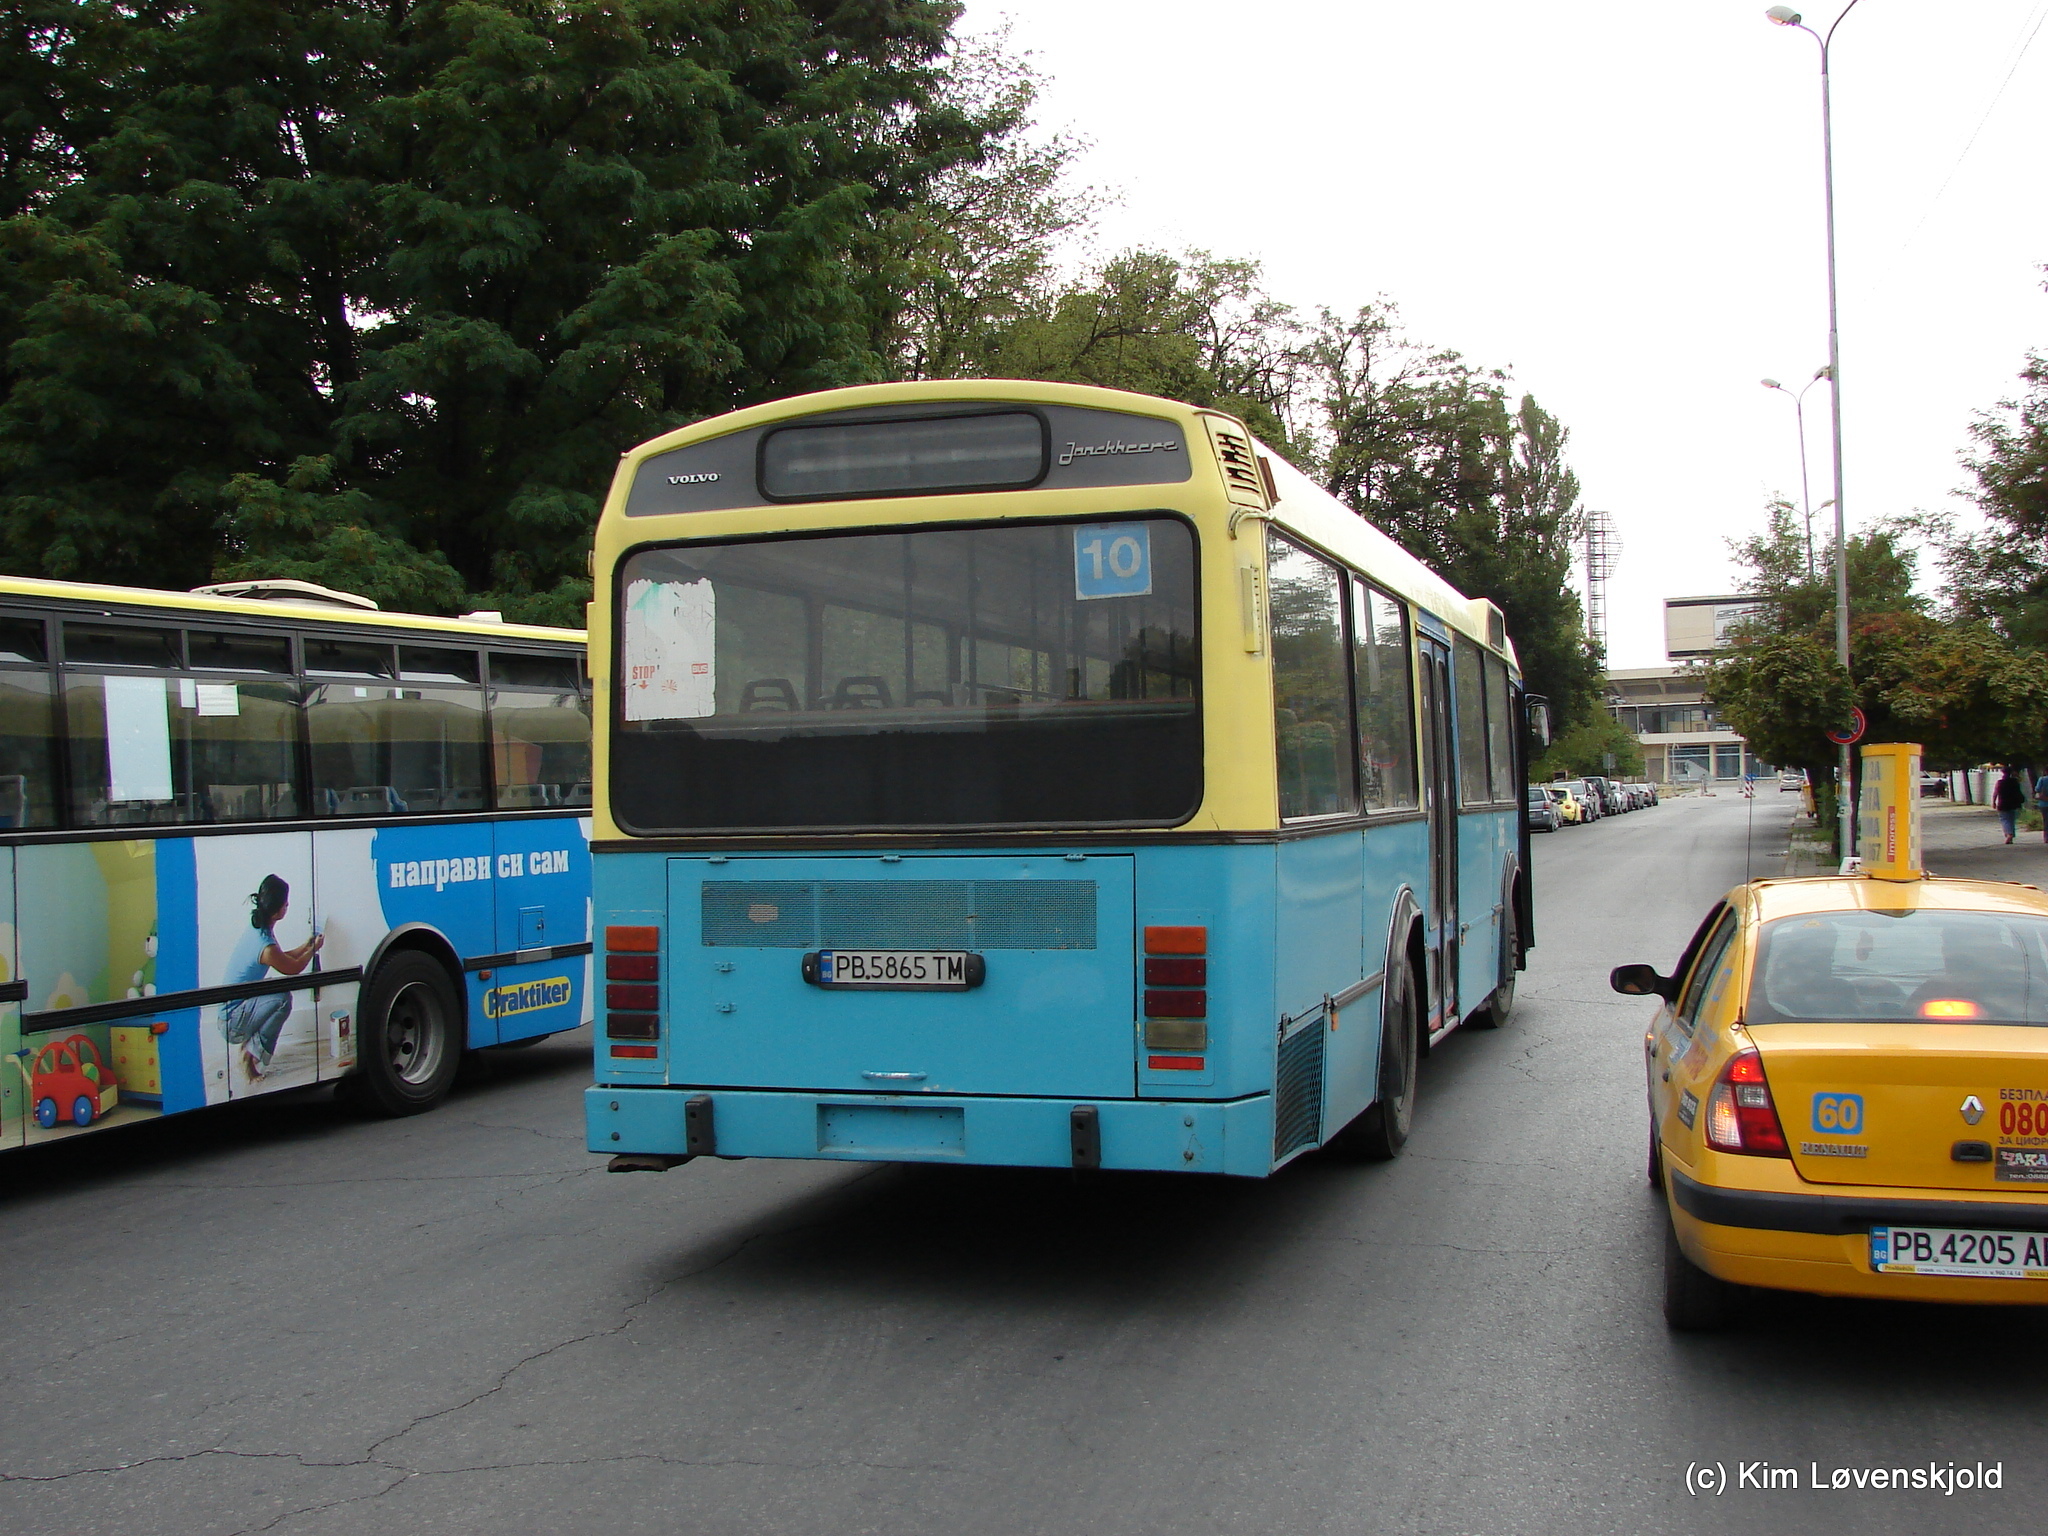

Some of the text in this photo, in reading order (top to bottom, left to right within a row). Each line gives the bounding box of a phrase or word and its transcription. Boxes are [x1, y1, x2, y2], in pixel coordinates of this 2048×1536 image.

[667, 472, 720, 485] VOLVO
[1082, 536, 1141, 579] 10
[632, 666, 655, 679] STOP
[390, 850, 569, 892] направи си сам
[933, 956, 963, 980] TM
[488, 981, 569, 1018] Praktiker
[1819, 1098, 1858, 1130] 60
[2000, 1102, 2048, 1136] 080
[1800, 1142, 1868, 1158] RENAULT
[1999, 1136, 2012, 1145] ЗА
[1873, 1250, 1888, 1260] BG
